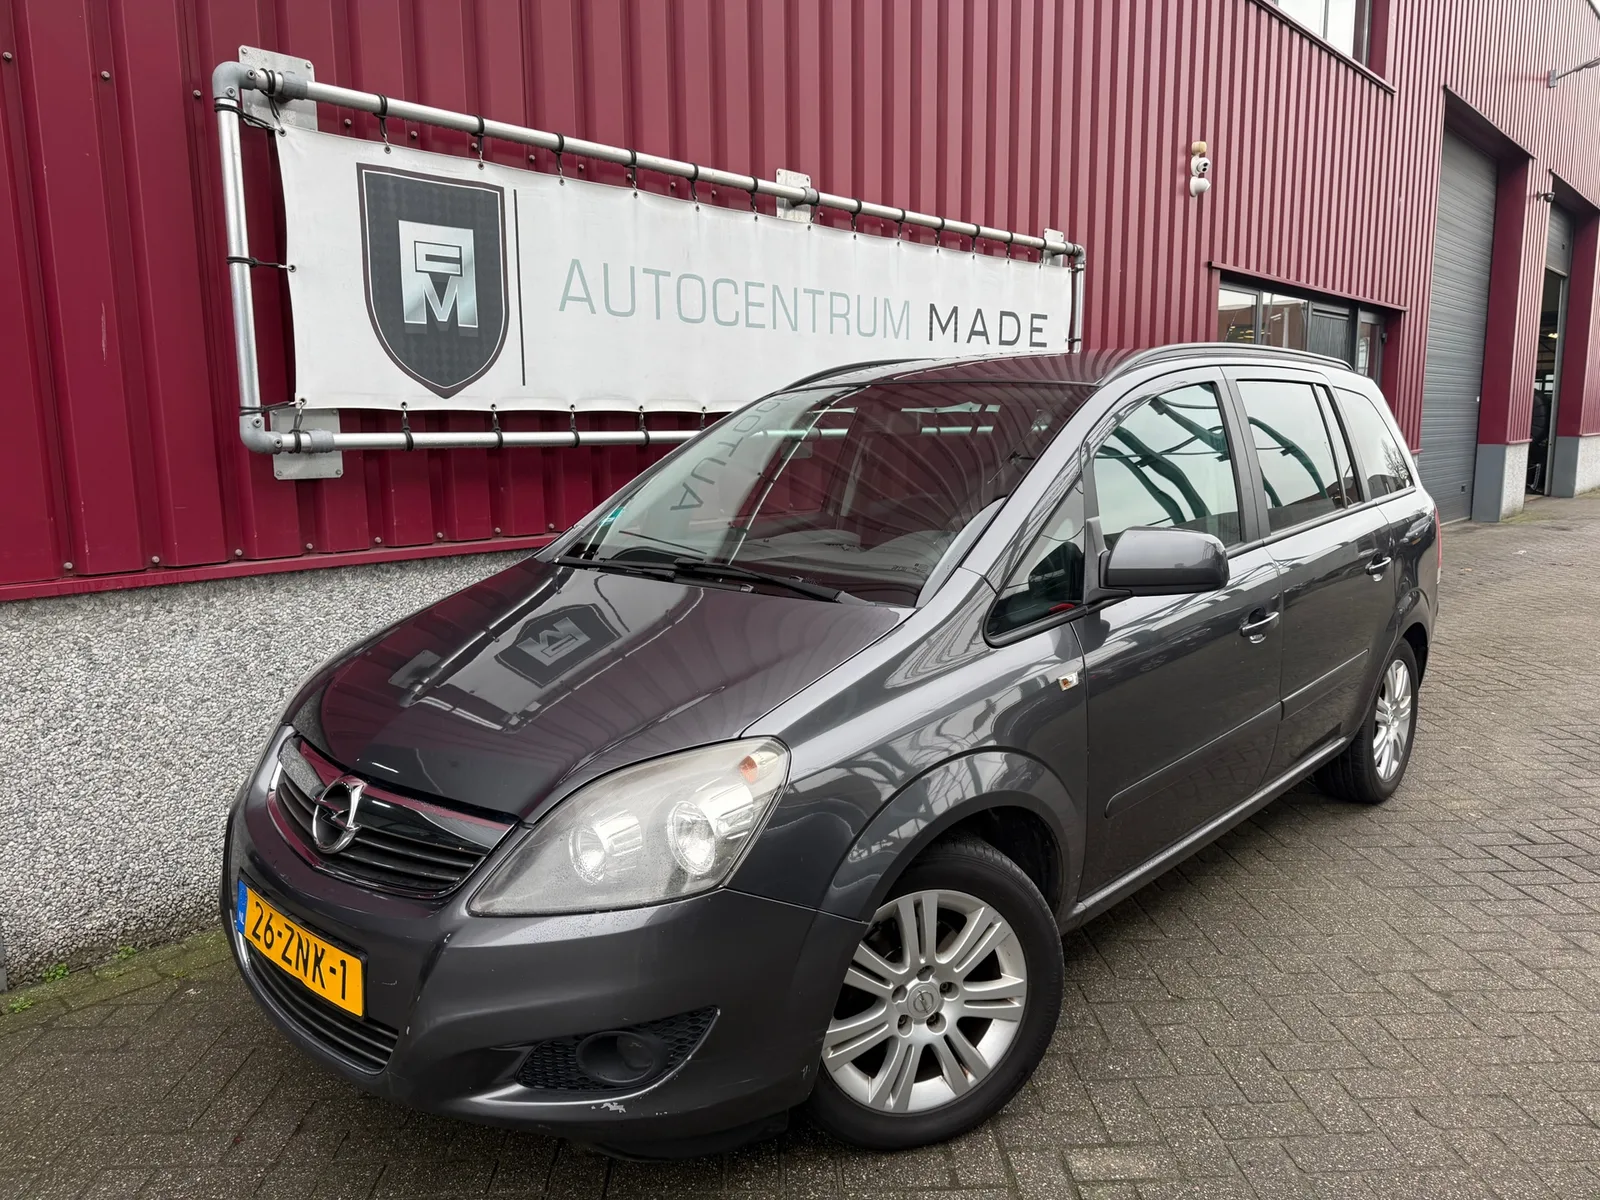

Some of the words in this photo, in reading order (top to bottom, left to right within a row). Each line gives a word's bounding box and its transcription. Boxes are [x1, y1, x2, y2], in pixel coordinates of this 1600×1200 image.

[558, 258, 911, 341] AUTOCENTRUM
[928, 303, 1048, 348] MADE
[251, 901, 347, 1001] 26-ZNK-1
